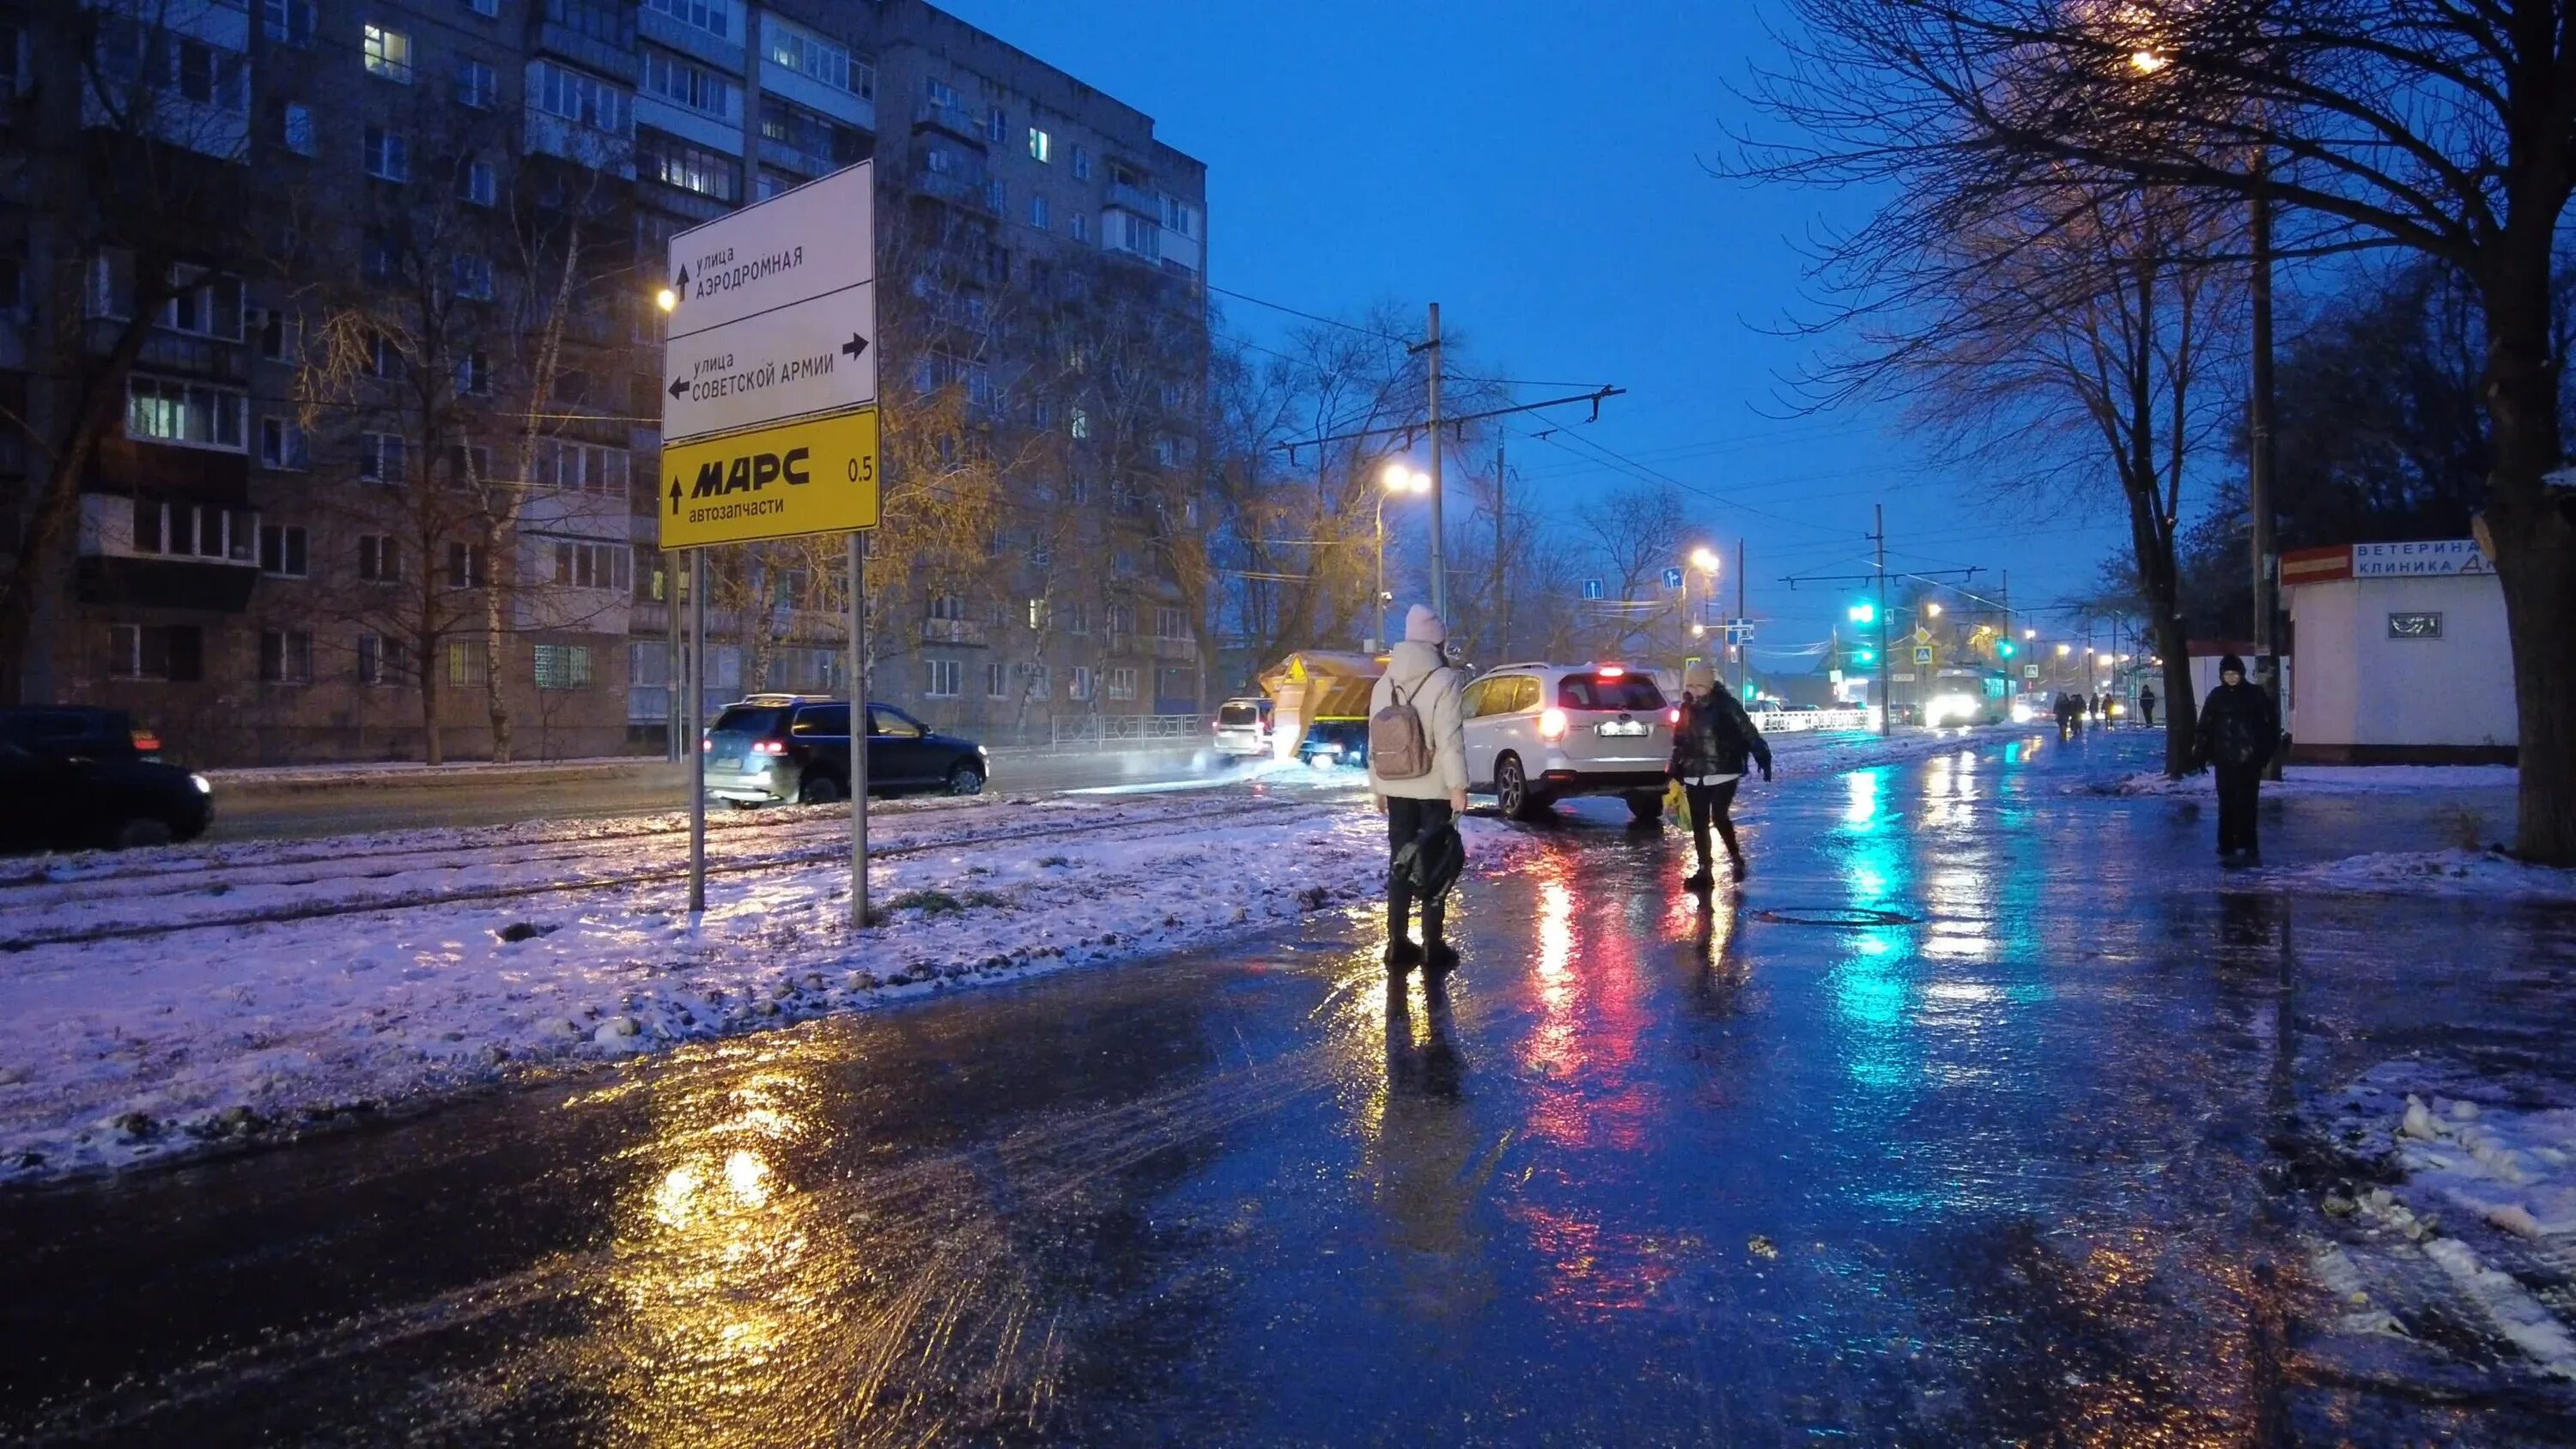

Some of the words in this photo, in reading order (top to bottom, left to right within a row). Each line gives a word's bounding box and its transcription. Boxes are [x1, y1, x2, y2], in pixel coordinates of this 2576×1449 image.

[696, 247, 733, 277] улица
[696, 246, 803, 300] АЭРОДРОМНАЯ
[692, 362, 775, 402] СОВЕТСКОЙ
[781, 353, 834, 384] АРМИИ
[694, 354, 733, 380] улица
[690, 446, 810, 500] МАРС
[848, 456, 872, 482] 0.5
[690, 498, 784, 523] автозапчасти
[2360, 561, 2452, 573] КЛИНИКА
